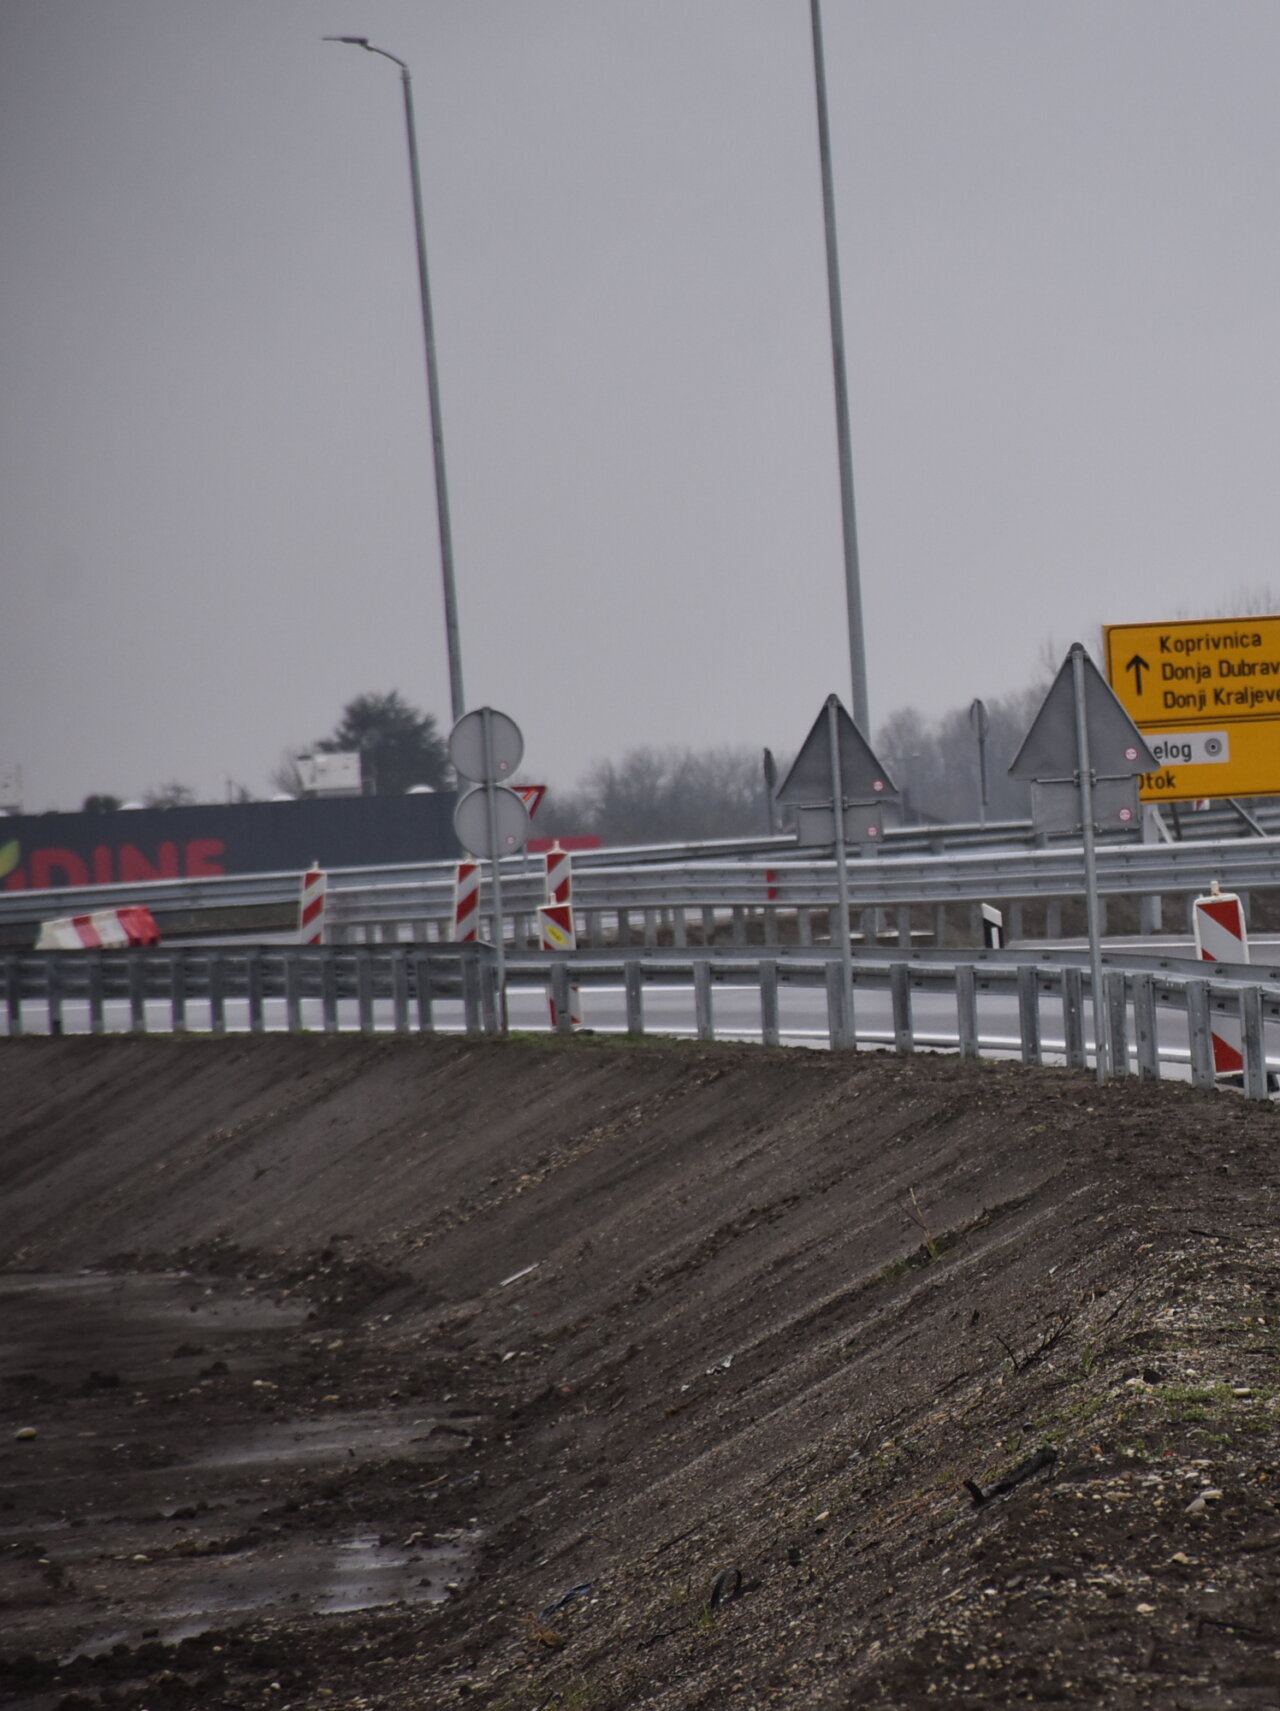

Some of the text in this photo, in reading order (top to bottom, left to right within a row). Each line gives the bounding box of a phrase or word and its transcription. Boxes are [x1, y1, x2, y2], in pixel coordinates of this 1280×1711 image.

[1160, 631, 1262, 656] Koprivnica
[1162, 661, 1212, 684] Donja
[1163, 689, 1207, 712] Donji
